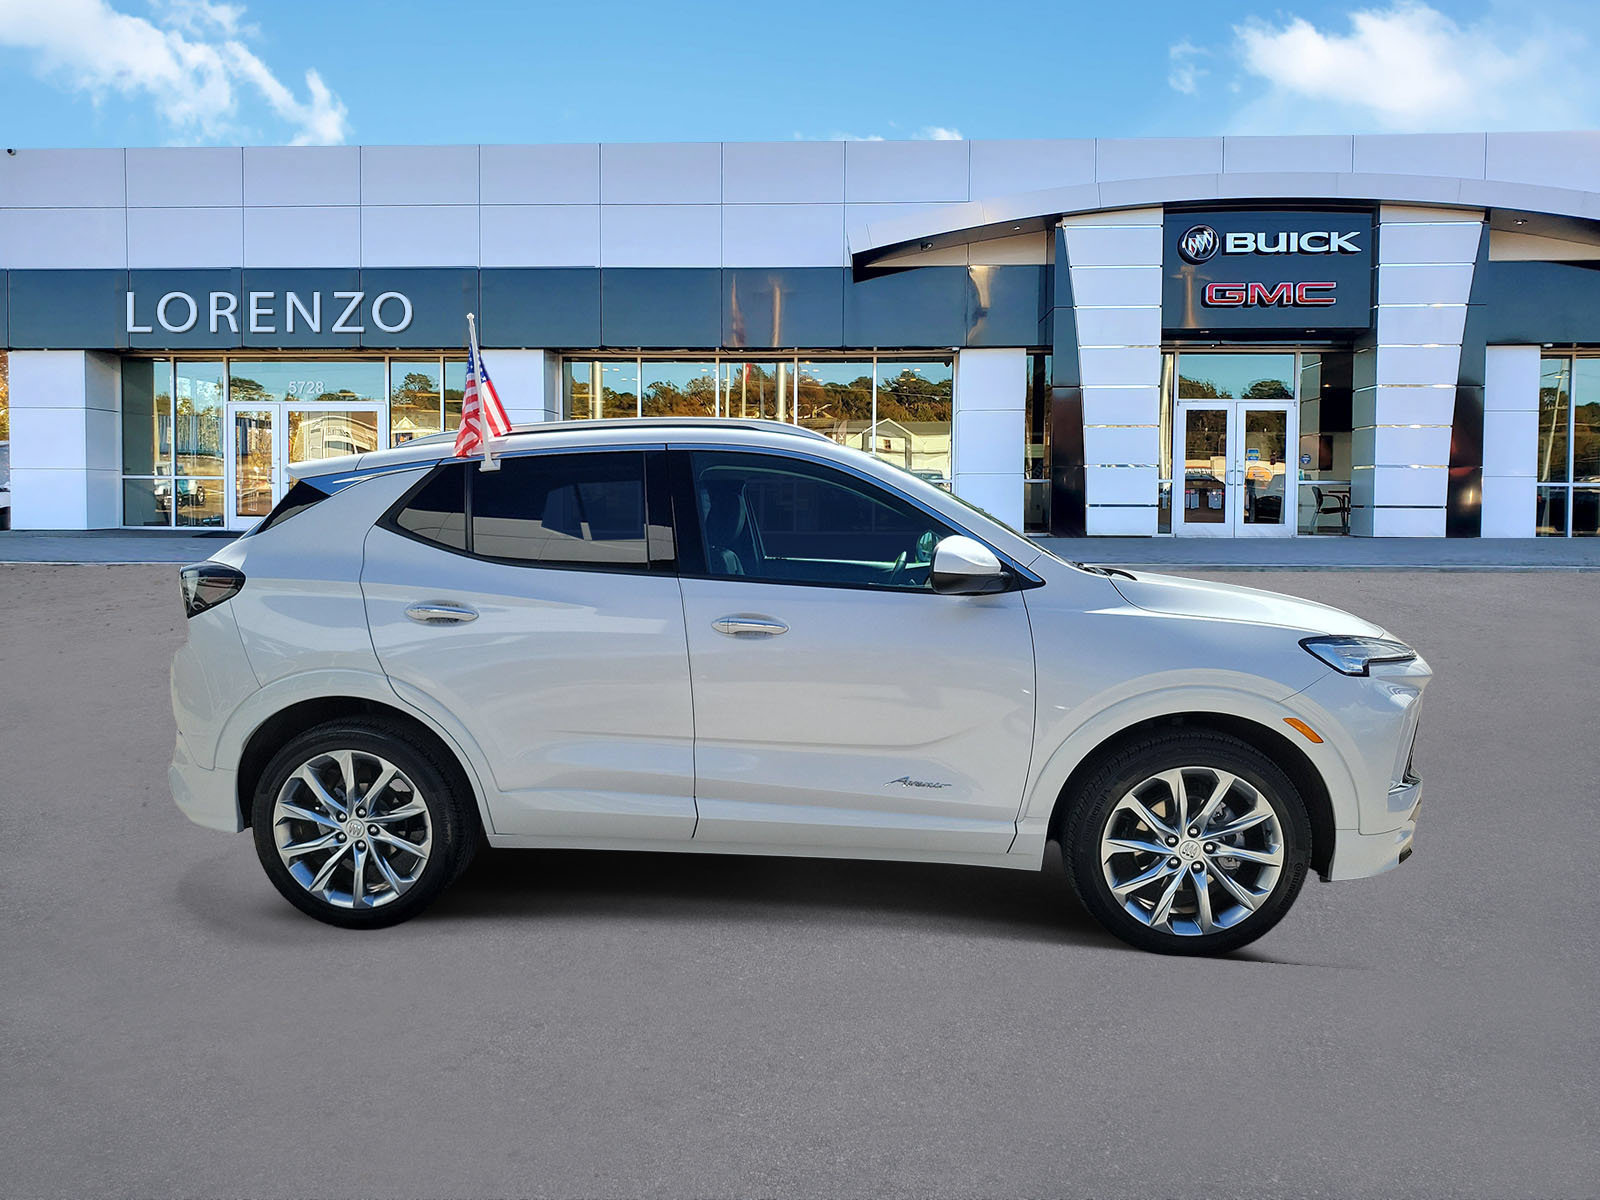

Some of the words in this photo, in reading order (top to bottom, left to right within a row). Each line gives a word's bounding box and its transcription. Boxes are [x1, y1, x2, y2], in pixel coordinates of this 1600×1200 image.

[1225, 232, 1362, 253] BUICK
[1204, 282, 1337, 305] GMC
[126, 291, 413, 334] LORENZO
[288, 381, 325, 395] 5728
